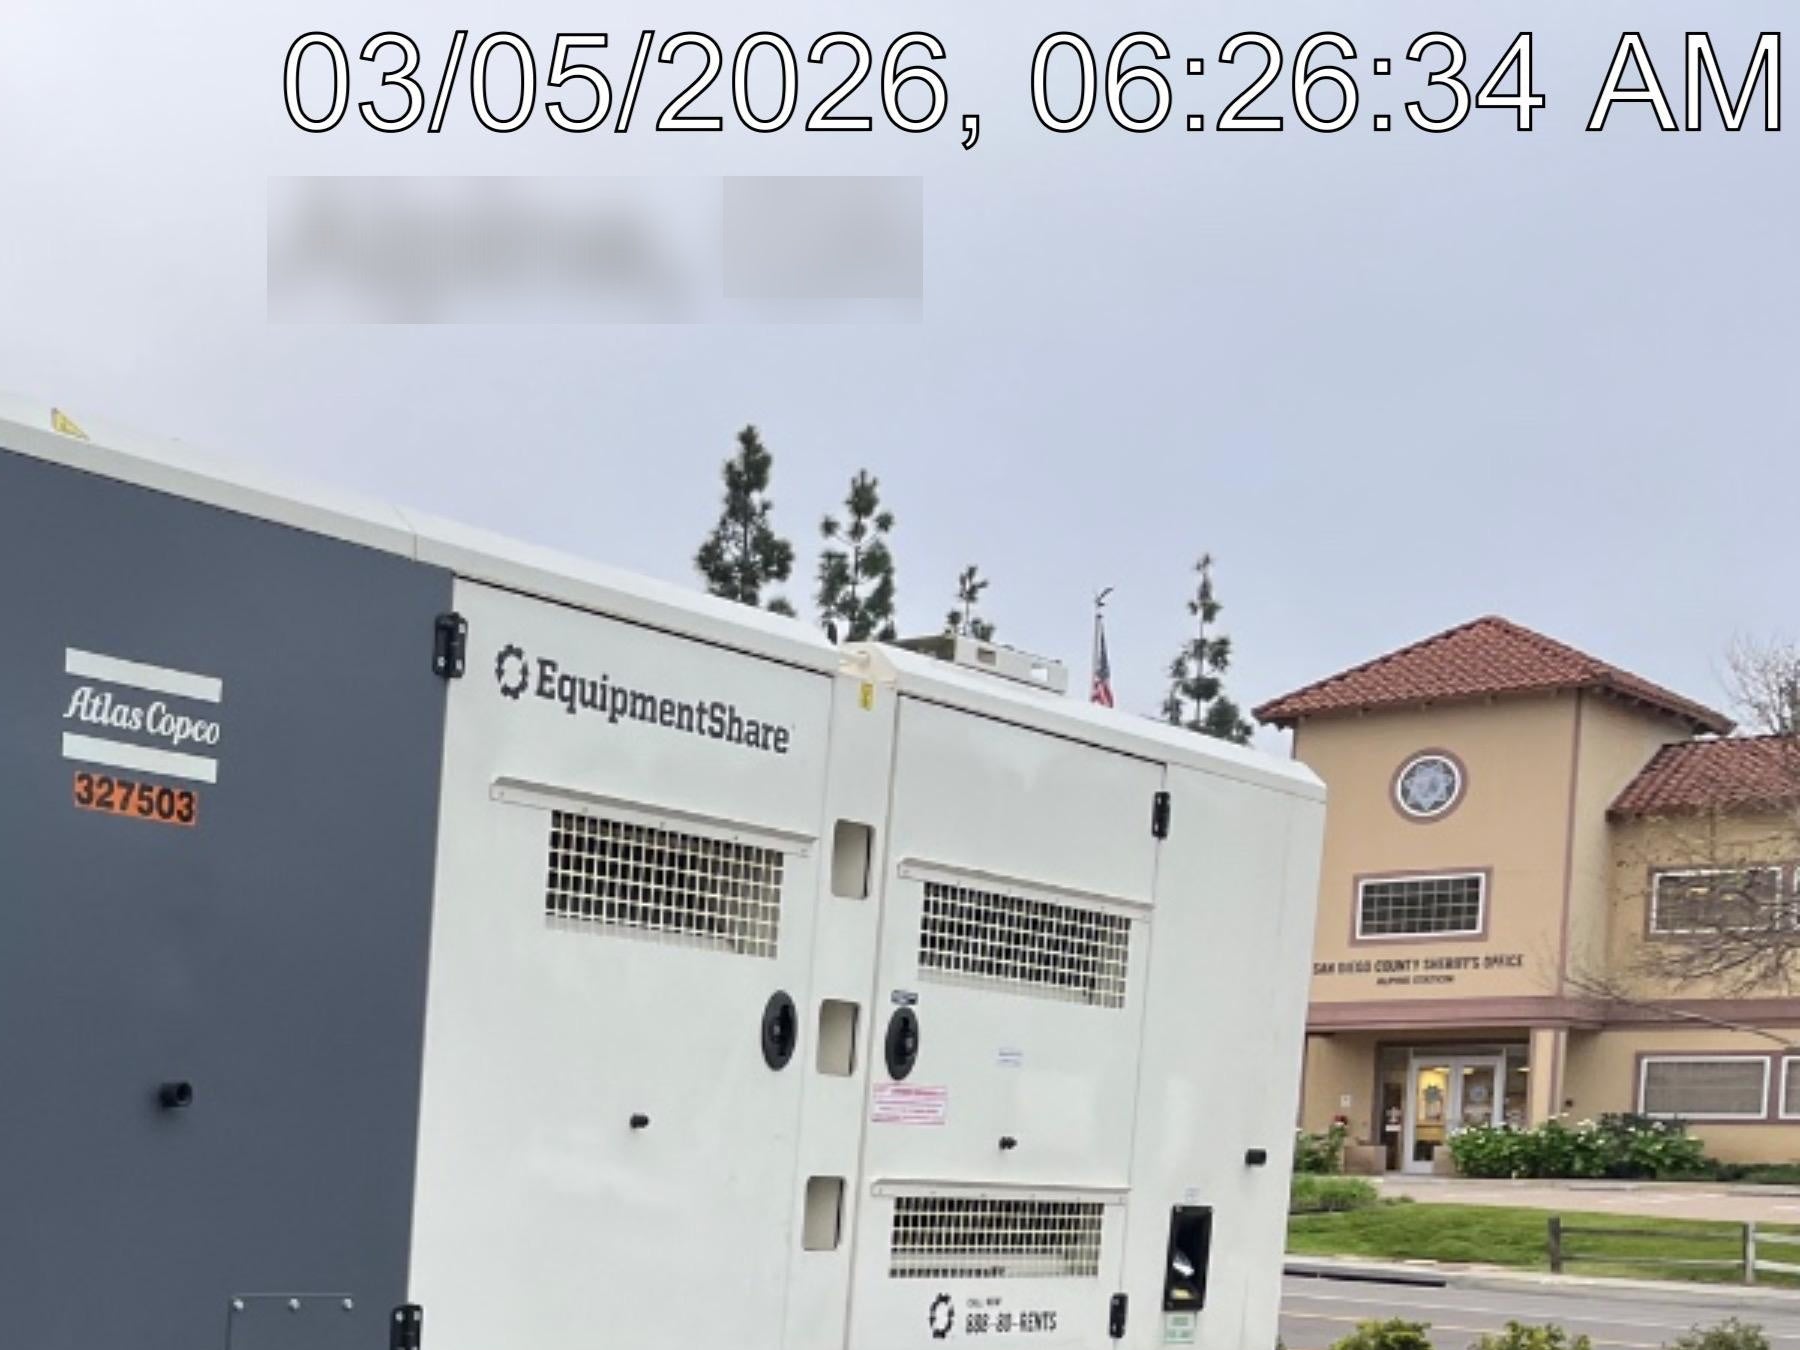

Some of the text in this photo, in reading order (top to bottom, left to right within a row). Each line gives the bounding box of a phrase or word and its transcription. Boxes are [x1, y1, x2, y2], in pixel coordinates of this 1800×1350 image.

[62, 685, 221, 746] Atlas Copco
[535, 655, 790, 754] EquipmentShare
[76, 773, 194, 823] 327503
